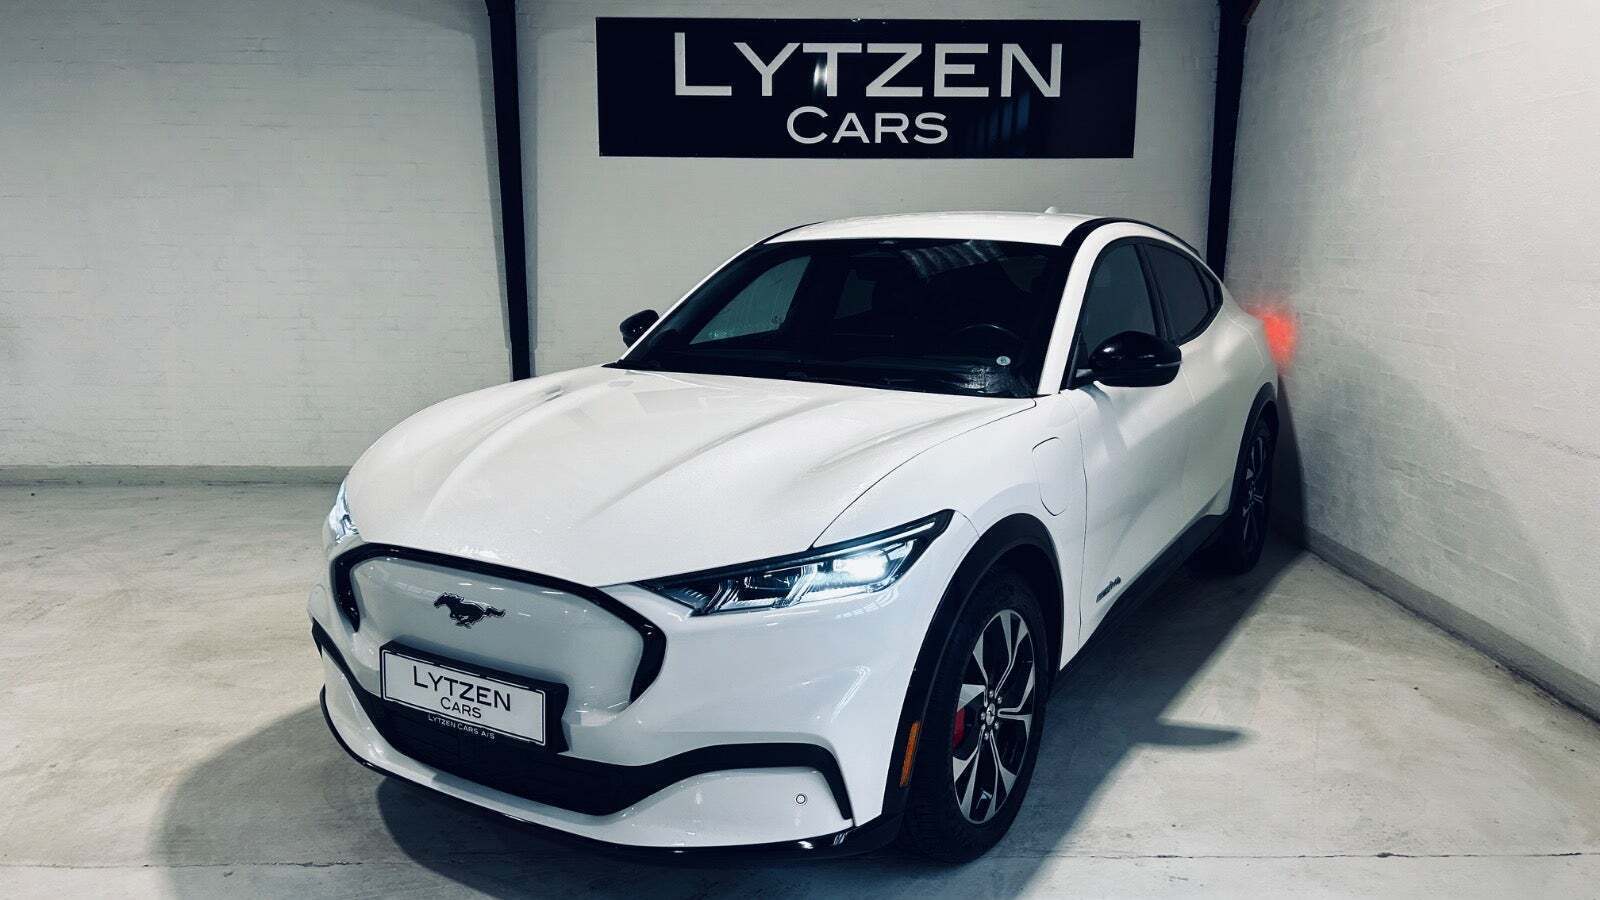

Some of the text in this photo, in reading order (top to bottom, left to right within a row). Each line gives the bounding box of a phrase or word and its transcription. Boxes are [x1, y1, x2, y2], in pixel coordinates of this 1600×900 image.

[674, 32, 1062, 98] LYTZEN
[786, 105, 949, 144] CARS
[413, 666, 511, 712] LYTZEN
[440, 696, 482, 719] CARS
[428, 714, 456, 729] LYTZEN
[457, 723, 479, 735] CARS
